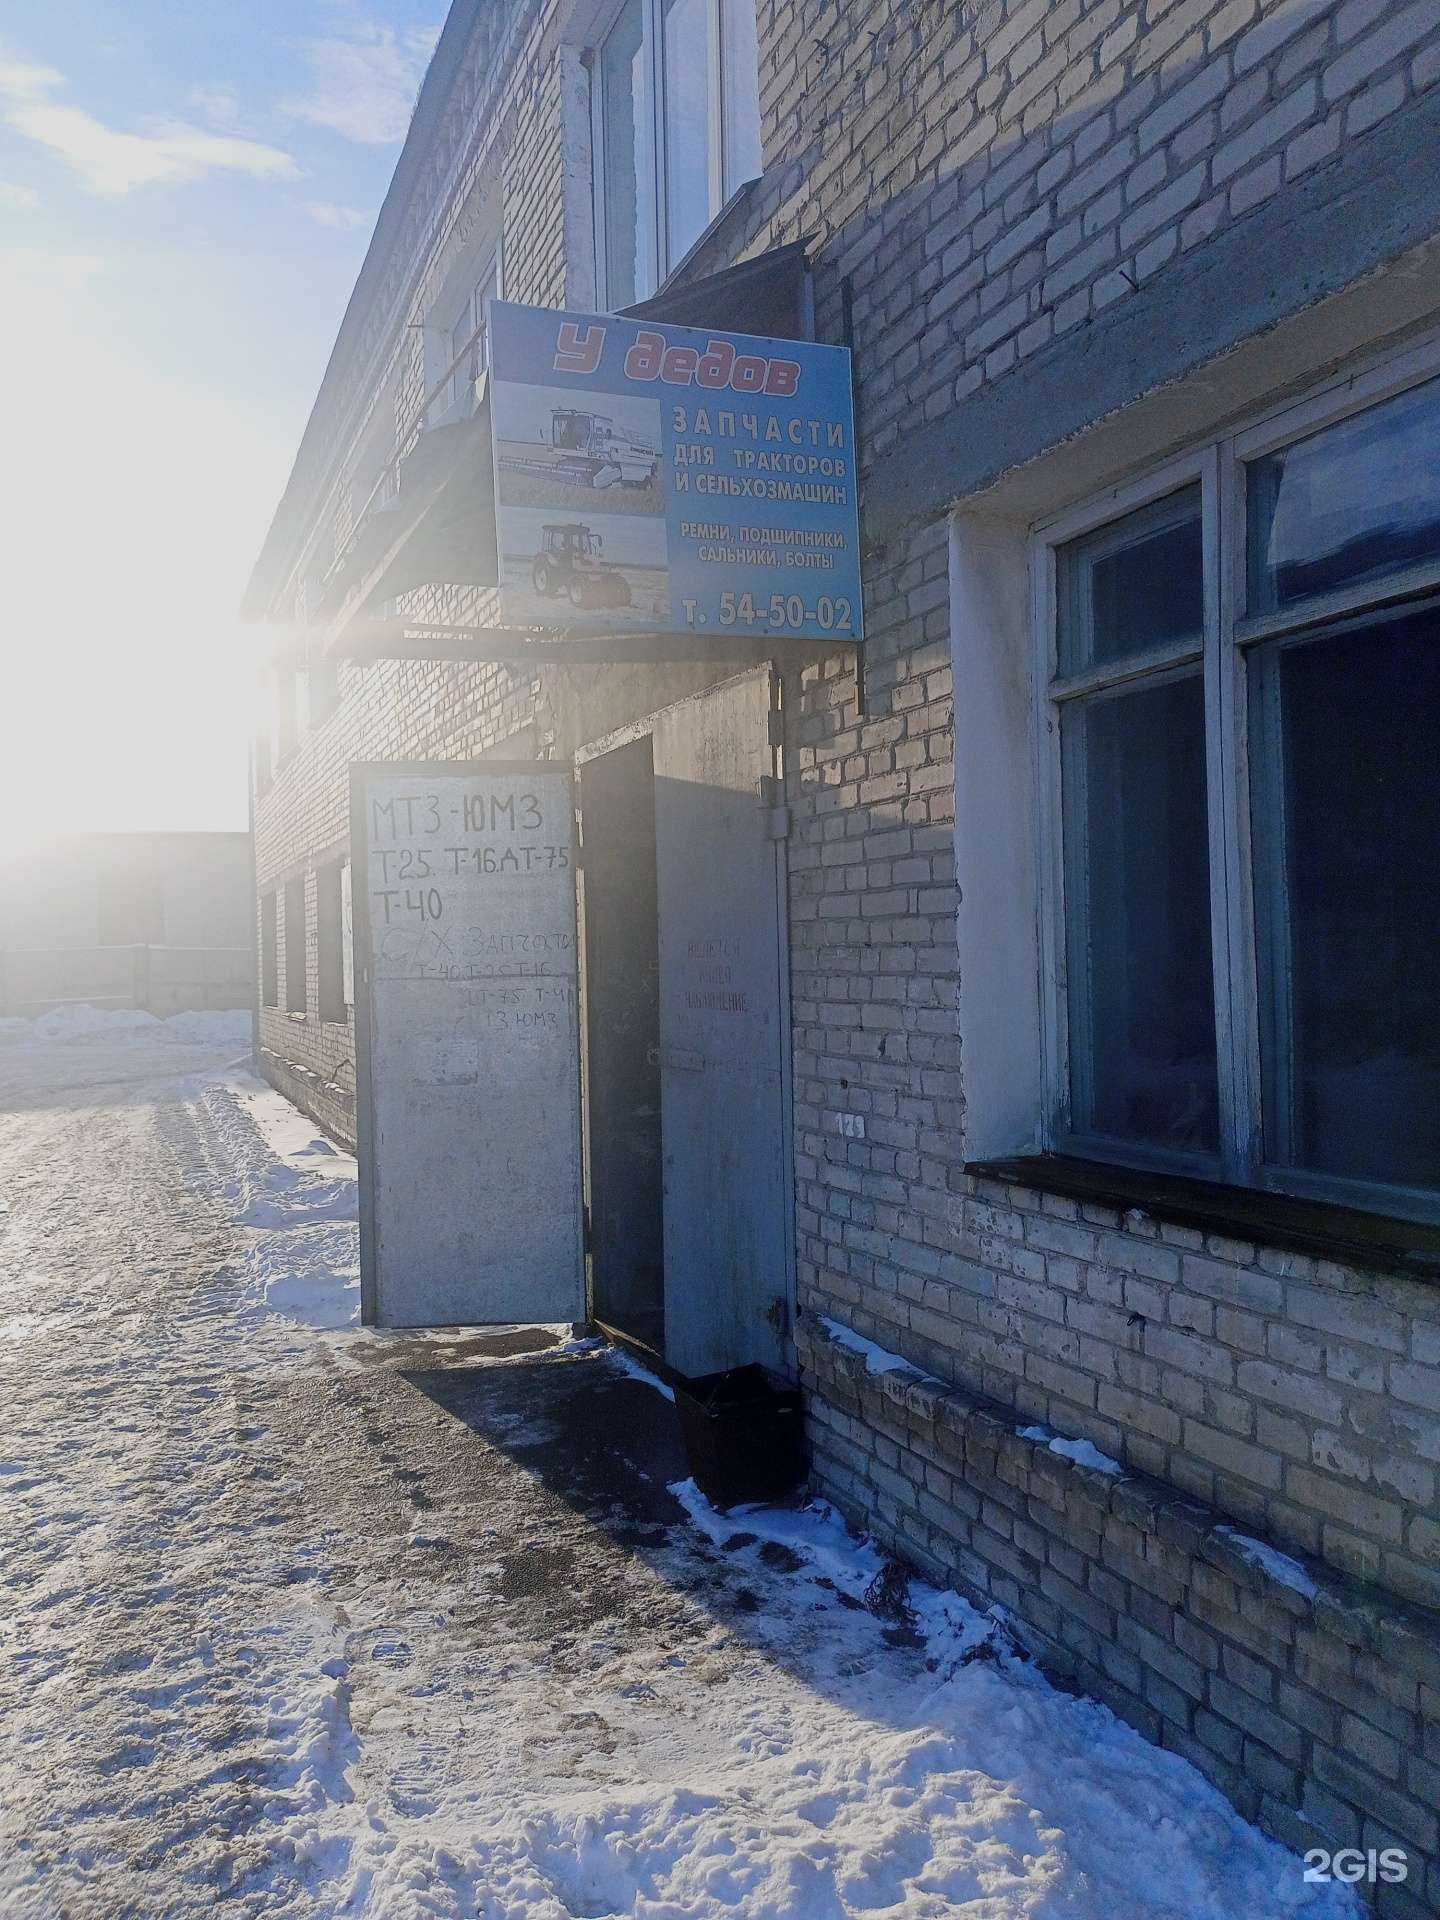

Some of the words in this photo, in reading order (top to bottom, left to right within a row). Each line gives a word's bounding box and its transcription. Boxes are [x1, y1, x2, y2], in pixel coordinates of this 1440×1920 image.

[672, 405, 846, 449] ЗАПЧАСТИ
[673, 443, 716, 467] ДЛЯ
[733, 449, 849, 478] ТРАКТОРОВ
[674, 472, 690, 493] И
[696, 473, 849, 505] СЕЛЬХОЗМАШИН
[680, 521, 736, 544] РЕМНИ,
[739, 527, 849, 550] ПОДШИПНИКИ,
[697, 546, 782, 568] САЛЬНИКИ,
[785, 551, 834, 570] БОЛТЫ
[718, 591, 853, 631] 54-50-02
[373, 887, 443, 924] Т-40
